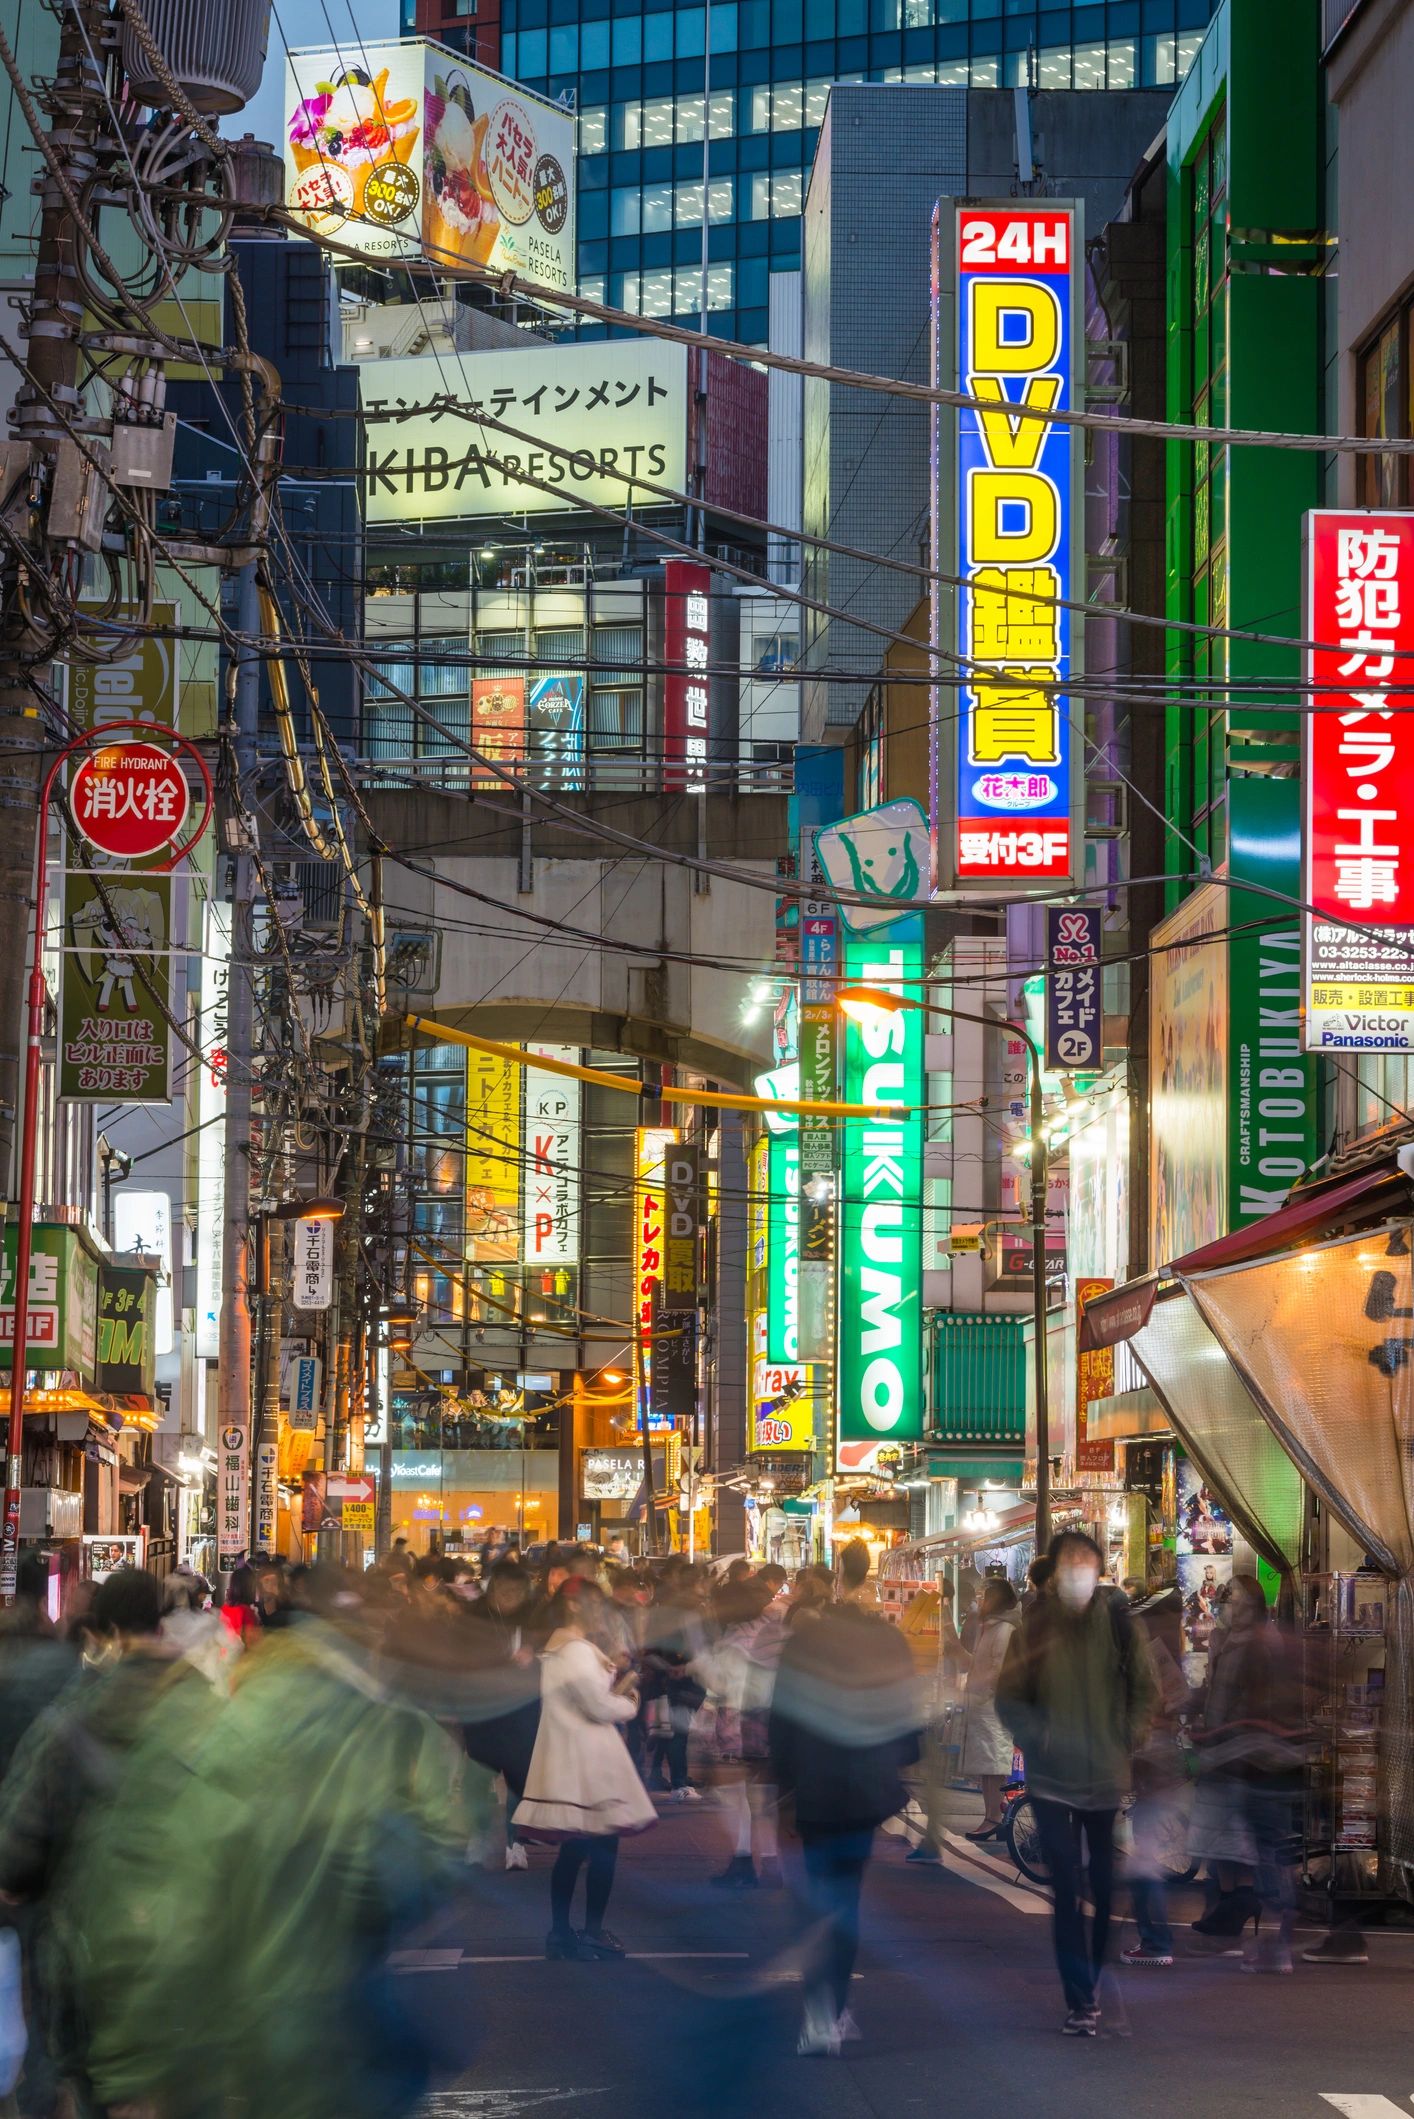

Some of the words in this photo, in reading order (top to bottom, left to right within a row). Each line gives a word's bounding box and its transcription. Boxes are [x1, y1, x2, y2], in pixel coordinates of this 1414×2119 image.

[374, 200, 401, 217] OK!
[545, 204, 562, 223] OK!
[364, 240, 408, 251] RESORTS
[529, 235, 561, 265] PASELA
[962, 222, 1067, 264] 24H
[528, 257, 568, 287] RESORTS
[365, 376, 669, 424] エンターテインメント
[369, 443, 491, 497] KIBA
[502, 444, 667, 485] RESORTS
[94, 757, 117, 769] FIRE
[120, 757, 169, 770] HYDRANT
[84, 777, 178, 821] 消火栓
[959, 832, 1067, 866] 受付3F
[807, 903, 830, 914] 6F
[810, 921, 828, 934] 4F
[1053, 945, 1097, 964] No.1
[1054, 972, 1075, 1025] カフェ
[1076, 967, 1096, 1028] メイド
[77, 1018, 153, 1041] 入り口は
[1345, 1013, 1408, 1030] Victor
[65, 1042, 163, 1065] ビル正面に
[1063, 1037, 1087, 1057] 2F
[1322, 1032, 1409, 1047] Panasonic
[79, 1067, 147, 1091] あります
[1239, 931, 1306, 1214] KOTOBUKIYA
[1240, 1044, 1250, 1165] CRAFTSMANSHIP
[556, 1135, 569, 1252] アニメコラボカフェ
[861, 949, 905, 1432] TSUKUMO
[306, 1235, 320, 1285] 千石電商
[115, 1288, 134, 1312] 3F
[588, 1459, 632, 1470] PASELA
[225, 1455, 240, 1532] 福山歯科
[260, 1467, 273, 1520] 千石電商
